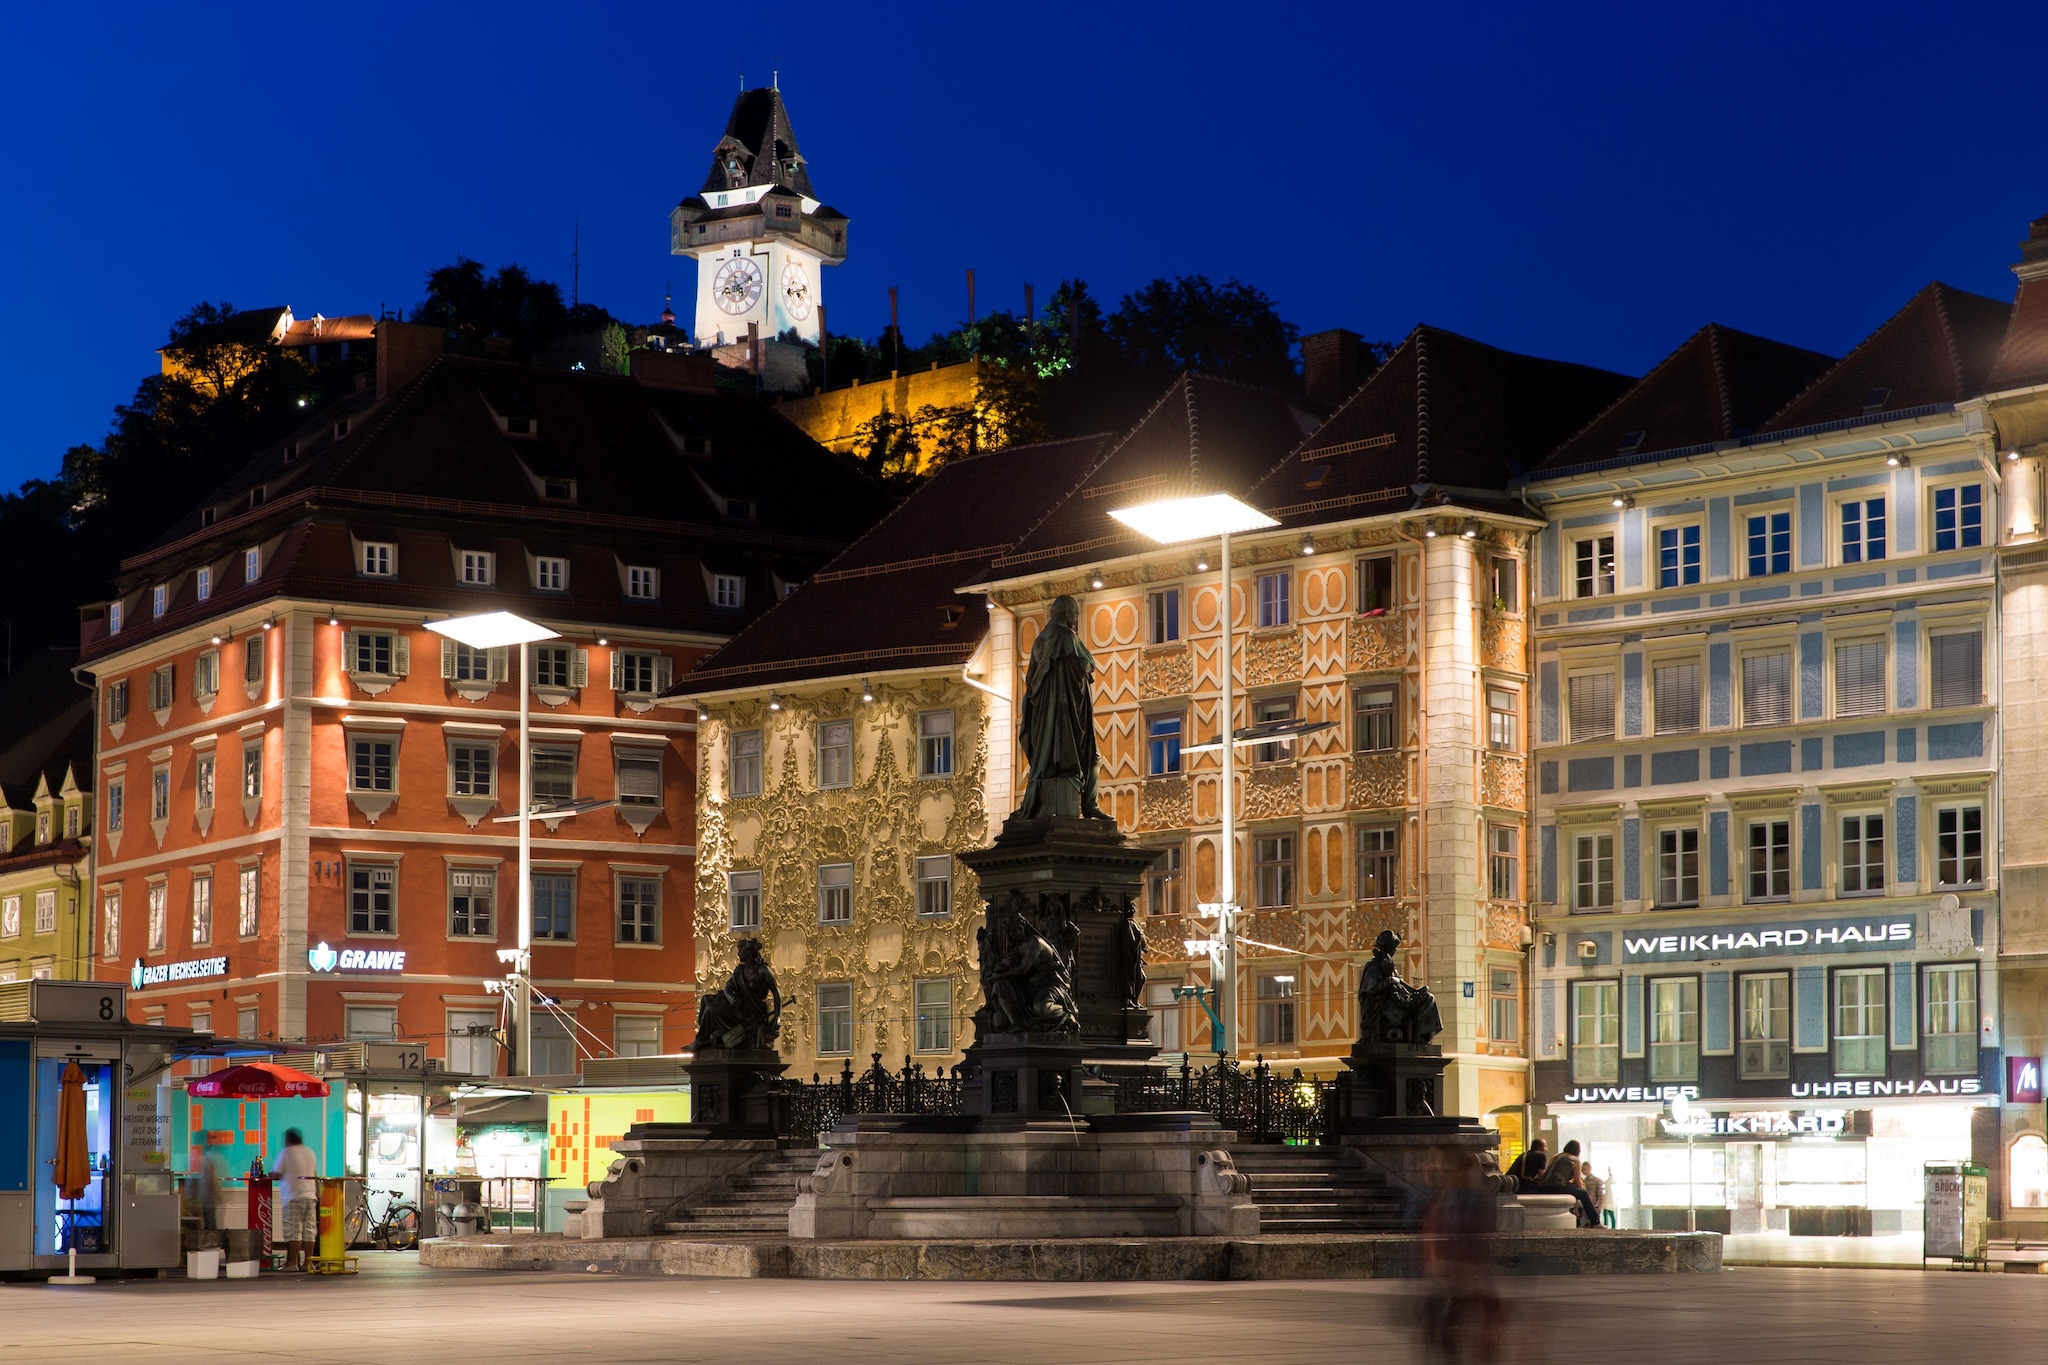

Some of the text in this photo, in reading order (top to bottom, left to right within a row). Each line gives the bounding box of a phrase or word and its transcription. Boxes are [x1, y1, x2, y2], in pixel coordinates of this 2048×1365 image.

[376, 872, 391, 881] 111
[1624, 923, 1911, 954] WEIKHARD HAUS
[340, 950, 406, 970] GRAWE
[142, 956, 227, 985] GRAZER WECHSELSEITIGE
[99, 996, 113, 1021] 8
[398, 1052, 419, 1069] 12
[1564, 1085, 1699, 1102] JUWELIER
[1791, 1079, 1981, 1097] UHRENHAUS
[137, 1104, 157, 1112] GYROS
[132, 1127, 161, 1135] HOT DOG
